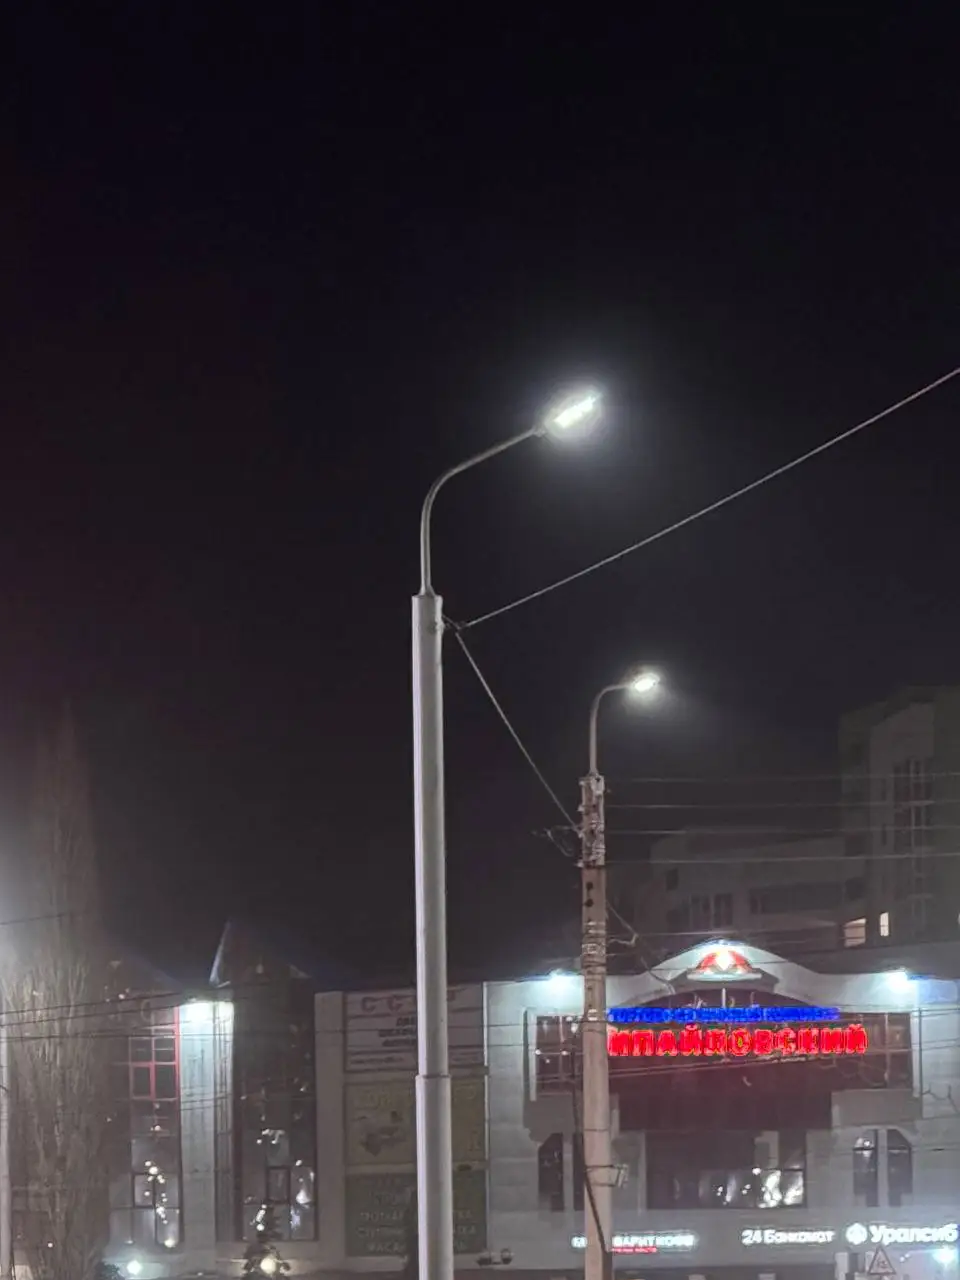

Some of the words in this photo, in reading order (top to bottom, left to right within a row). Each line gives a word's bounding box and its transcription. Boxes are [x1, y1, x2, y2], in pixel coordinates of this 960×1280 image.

[607, 1023, 868, 1056] ИПАЙЛОВСКИЙ
[742, 1229, 762, 1245] 24
[764, 1229, 835, 1244] Банкомат
[869, 1223, 958, 1246] Уралсиб
